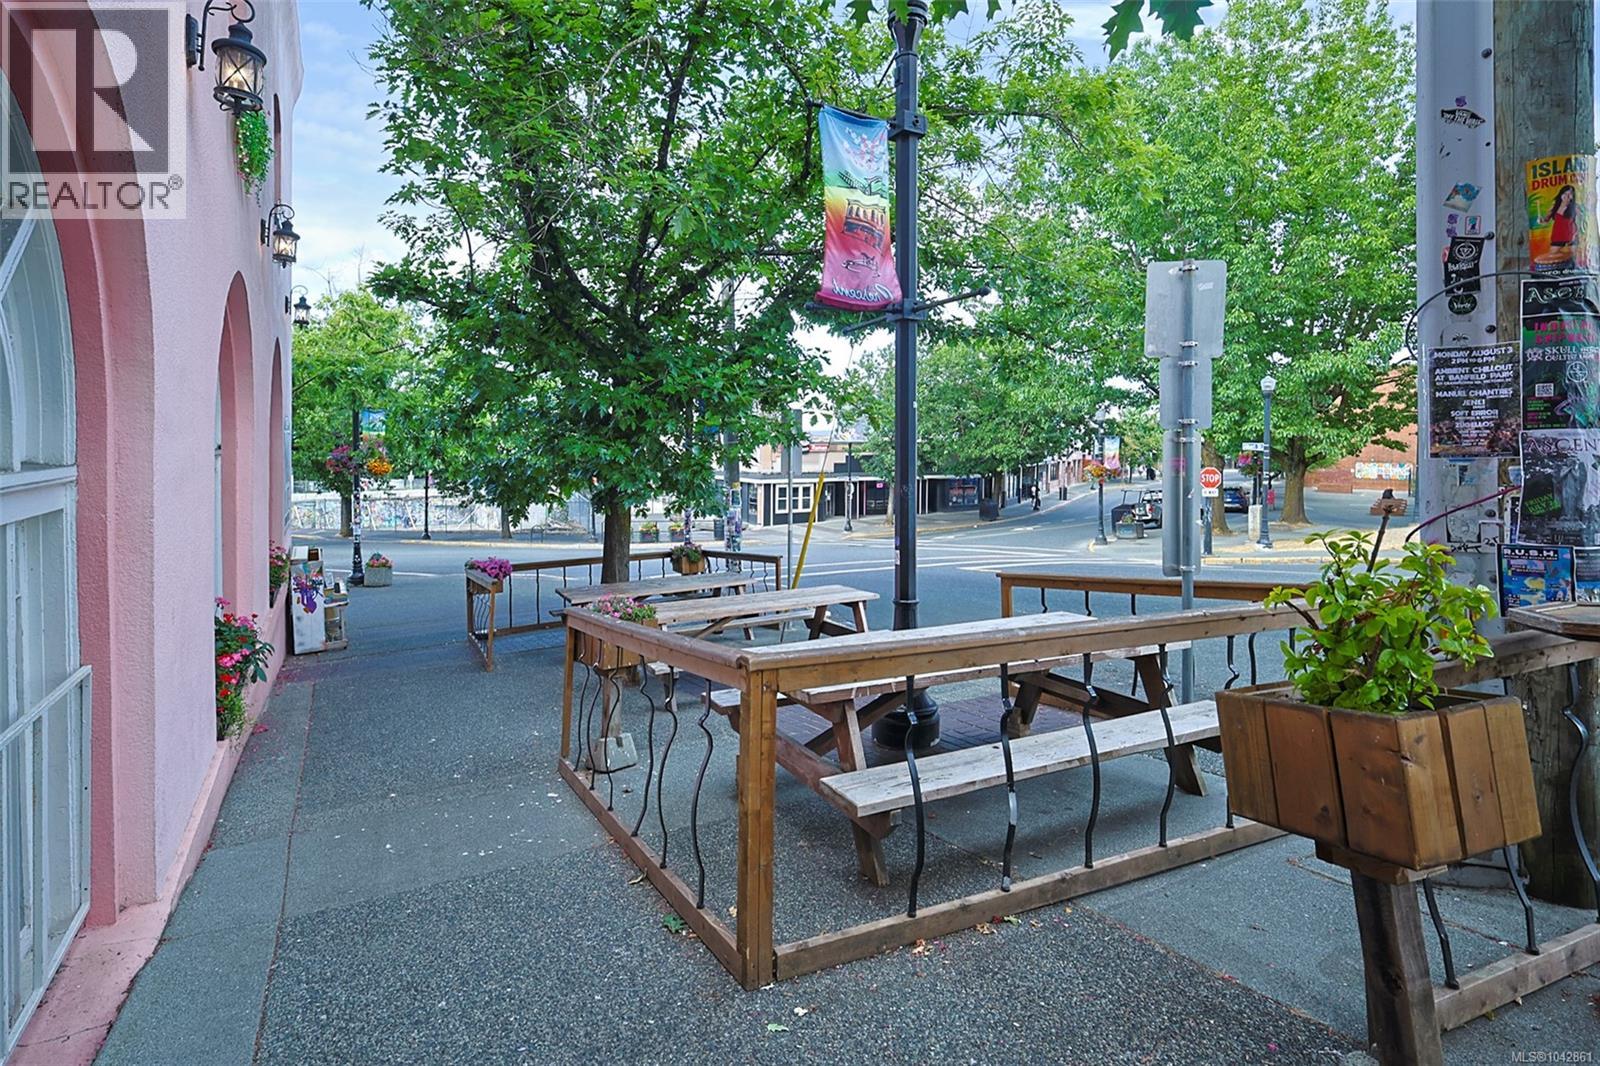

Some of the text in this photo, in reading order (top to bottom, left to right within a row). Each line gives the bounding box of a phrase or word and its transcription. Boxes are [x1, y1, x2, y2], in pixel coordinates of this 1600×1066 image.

[1532, 174, 1567, 191] DRUM
[1433, 350, 1470, 359] MONDAY
[1471, 347, 1506, 357] AUGUST
[1435, 363, 1513, 375] AMBIENT CHILLOUT
[1448, 373, 1486, 381] BANFIELD
[1490, 370, 1514, 379] PARK
[1524, 437, 1600, 456] ASCEN
[1201, 473, 1219, 483] STOP
